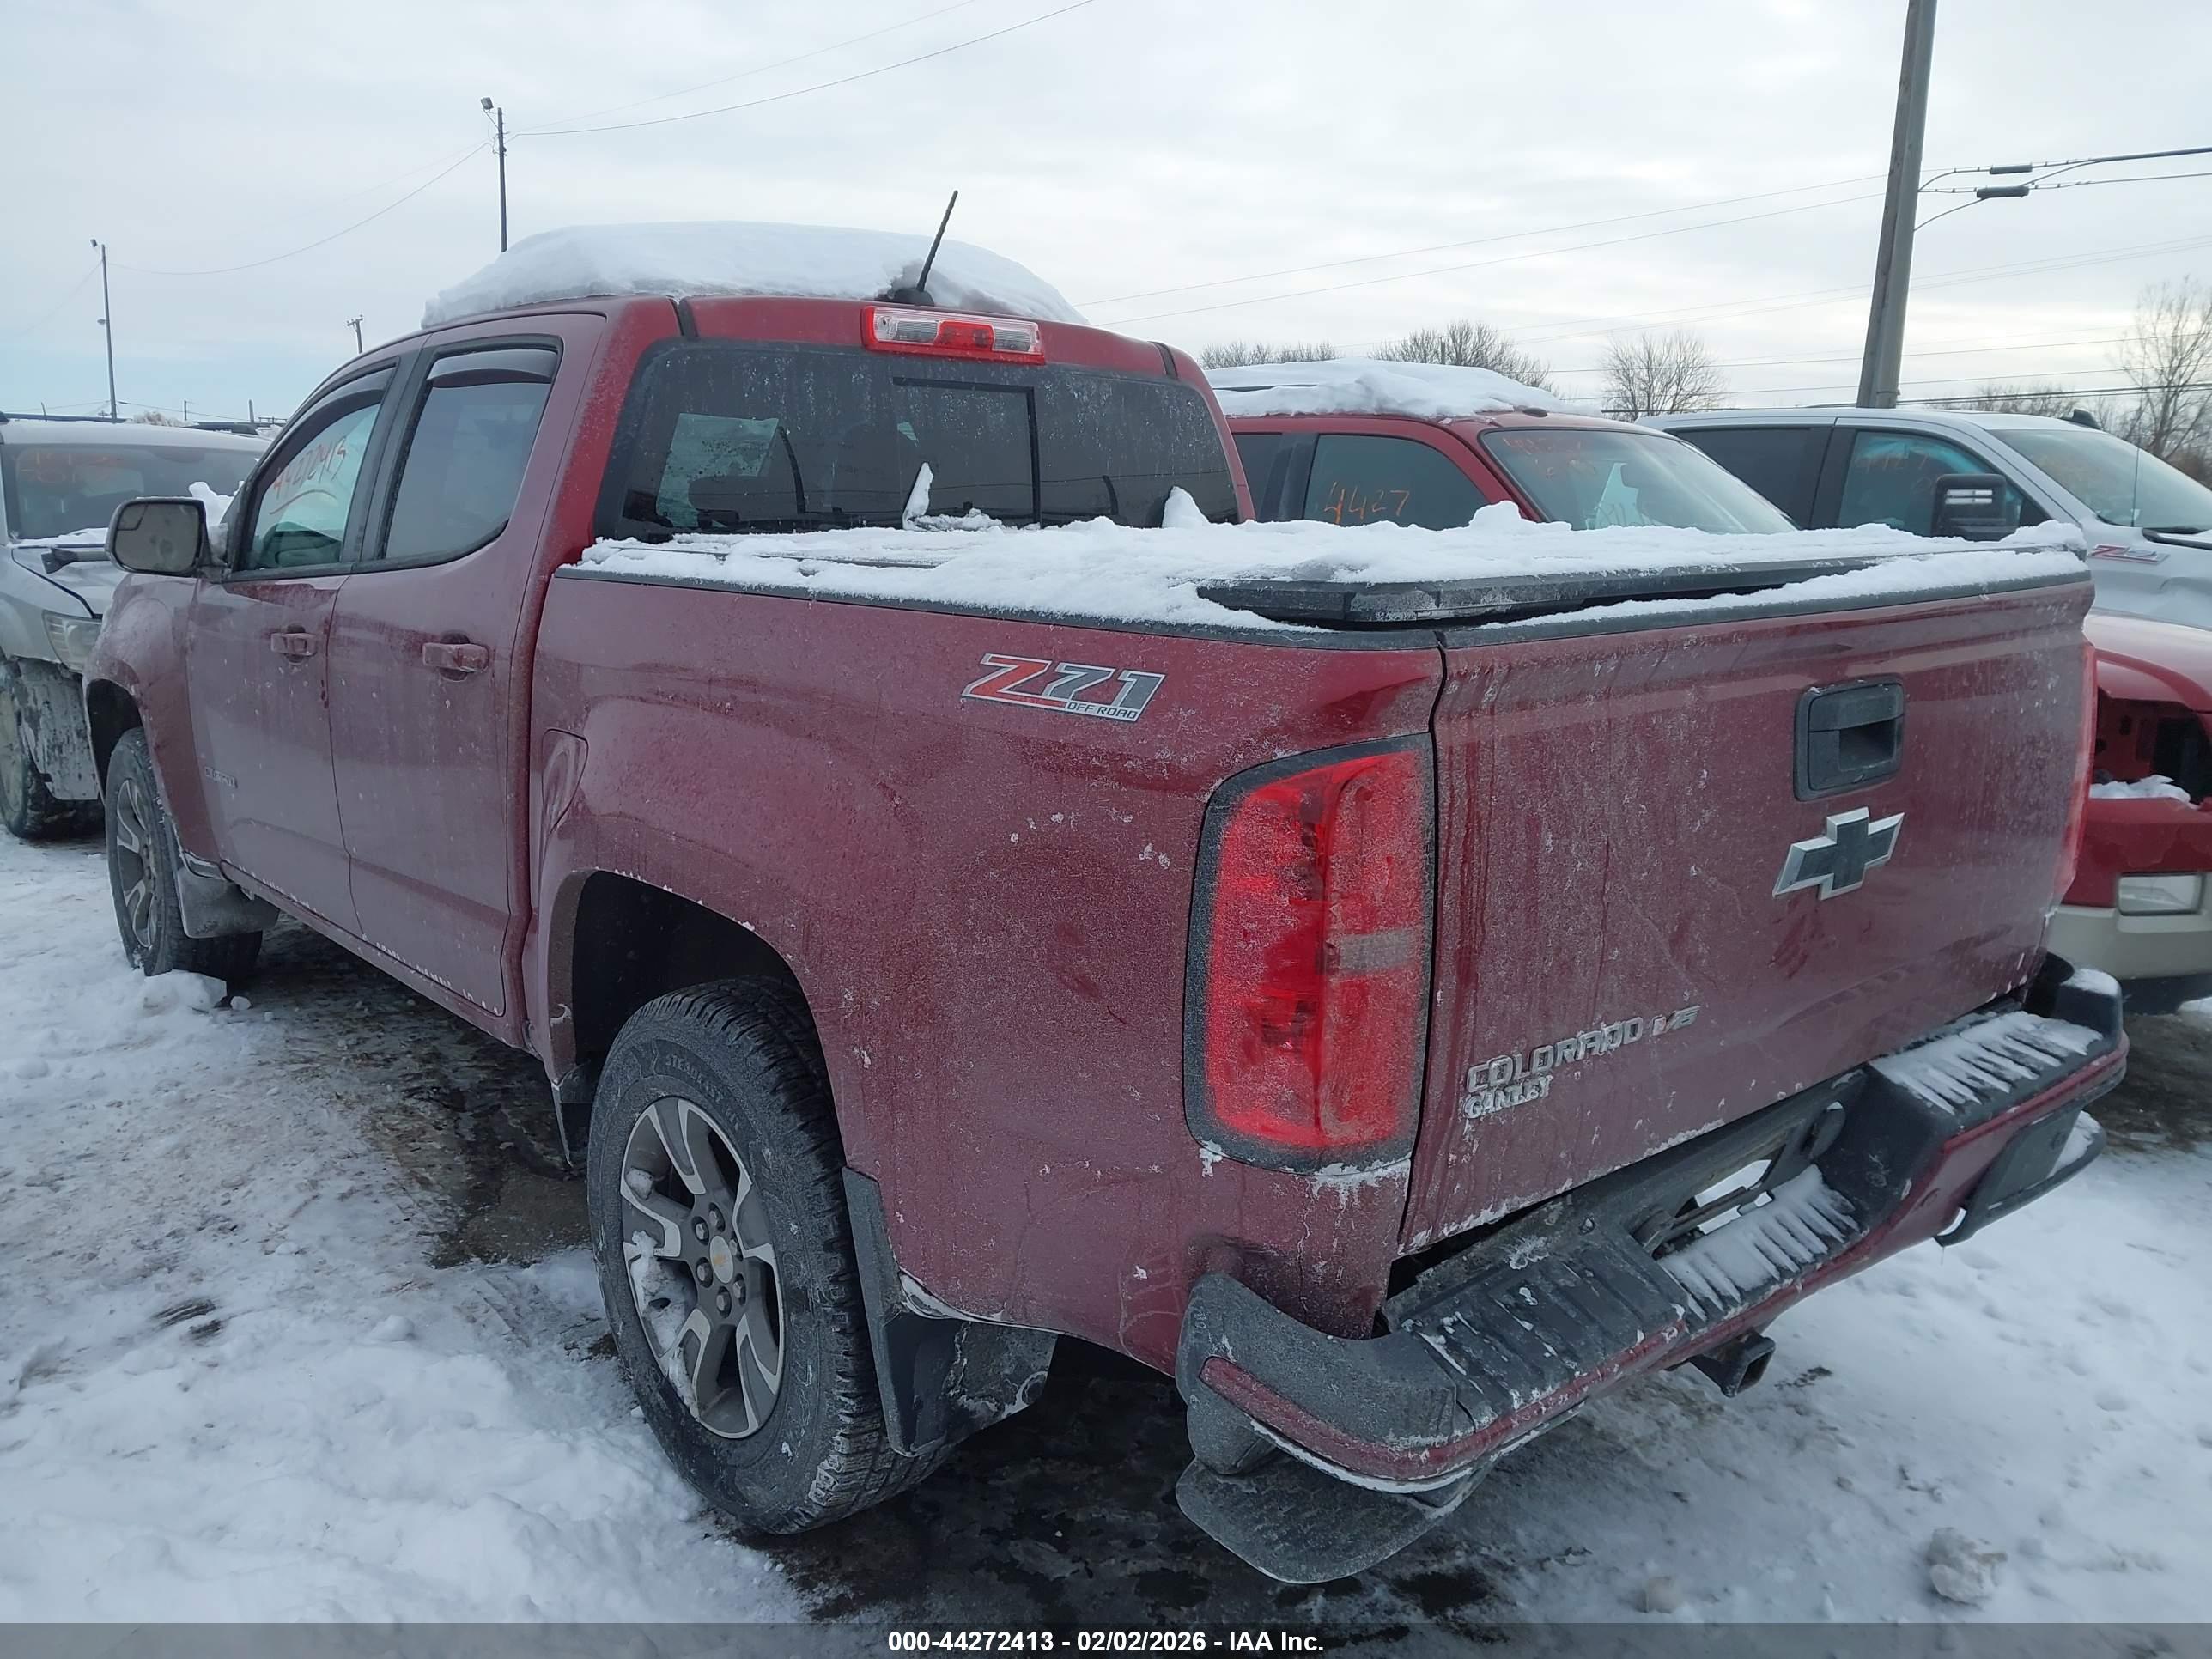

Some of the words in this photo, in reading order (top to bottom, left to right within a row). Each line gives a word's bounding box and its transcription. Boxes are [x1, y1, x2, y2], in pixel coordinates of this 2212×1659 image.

[962, 653, 1166, 718] Z71
[1066, 702, 1097, 714] OFF
[1096, 707, 1140, 720] ROAD
[1466, 1016, 1644, 1093] COLORADO
